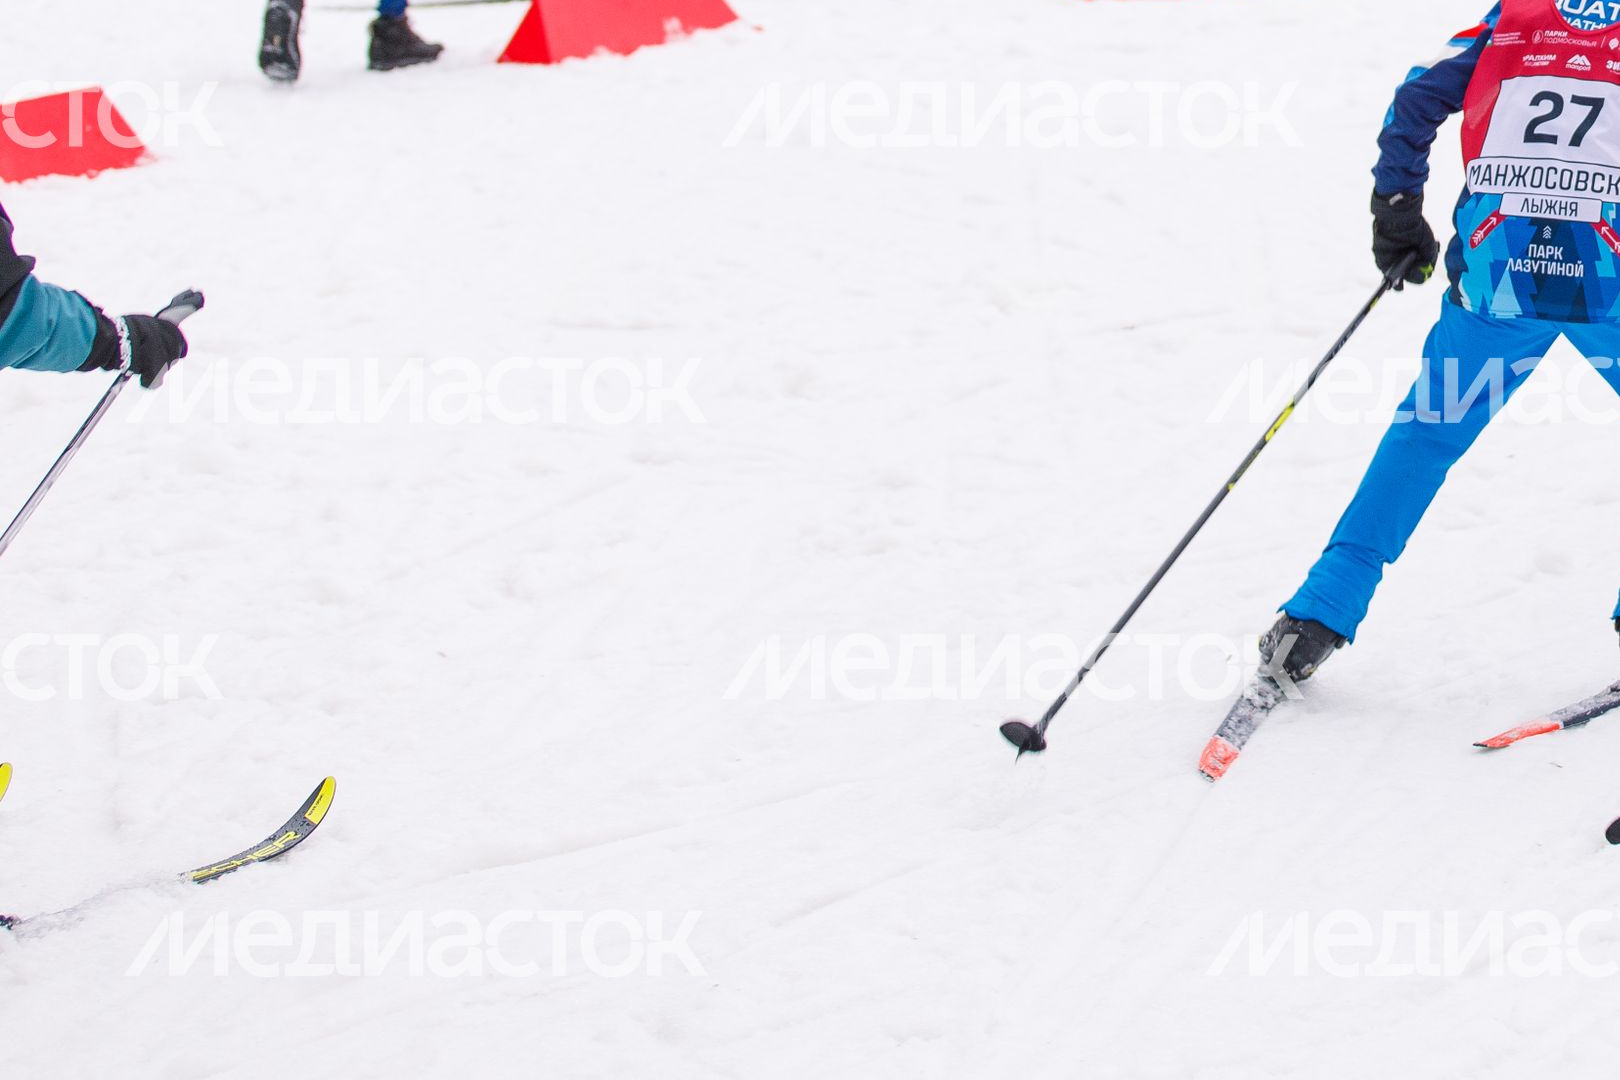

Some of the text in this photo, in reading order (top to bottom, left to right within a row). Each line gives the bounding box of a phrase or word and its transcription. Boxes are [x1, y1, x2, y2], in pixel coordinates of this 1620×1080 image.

[1544, 30, 1568, 38] ПАРКИ
[1523, 90, 1605, 148] 27
[1520, 197, 1579, 217] ЛЫЖНЯ
[1528, 243, 1563, 260] ПАРК
[1506, 257, 1584, 278] ЛАЗУТИНОЙ
